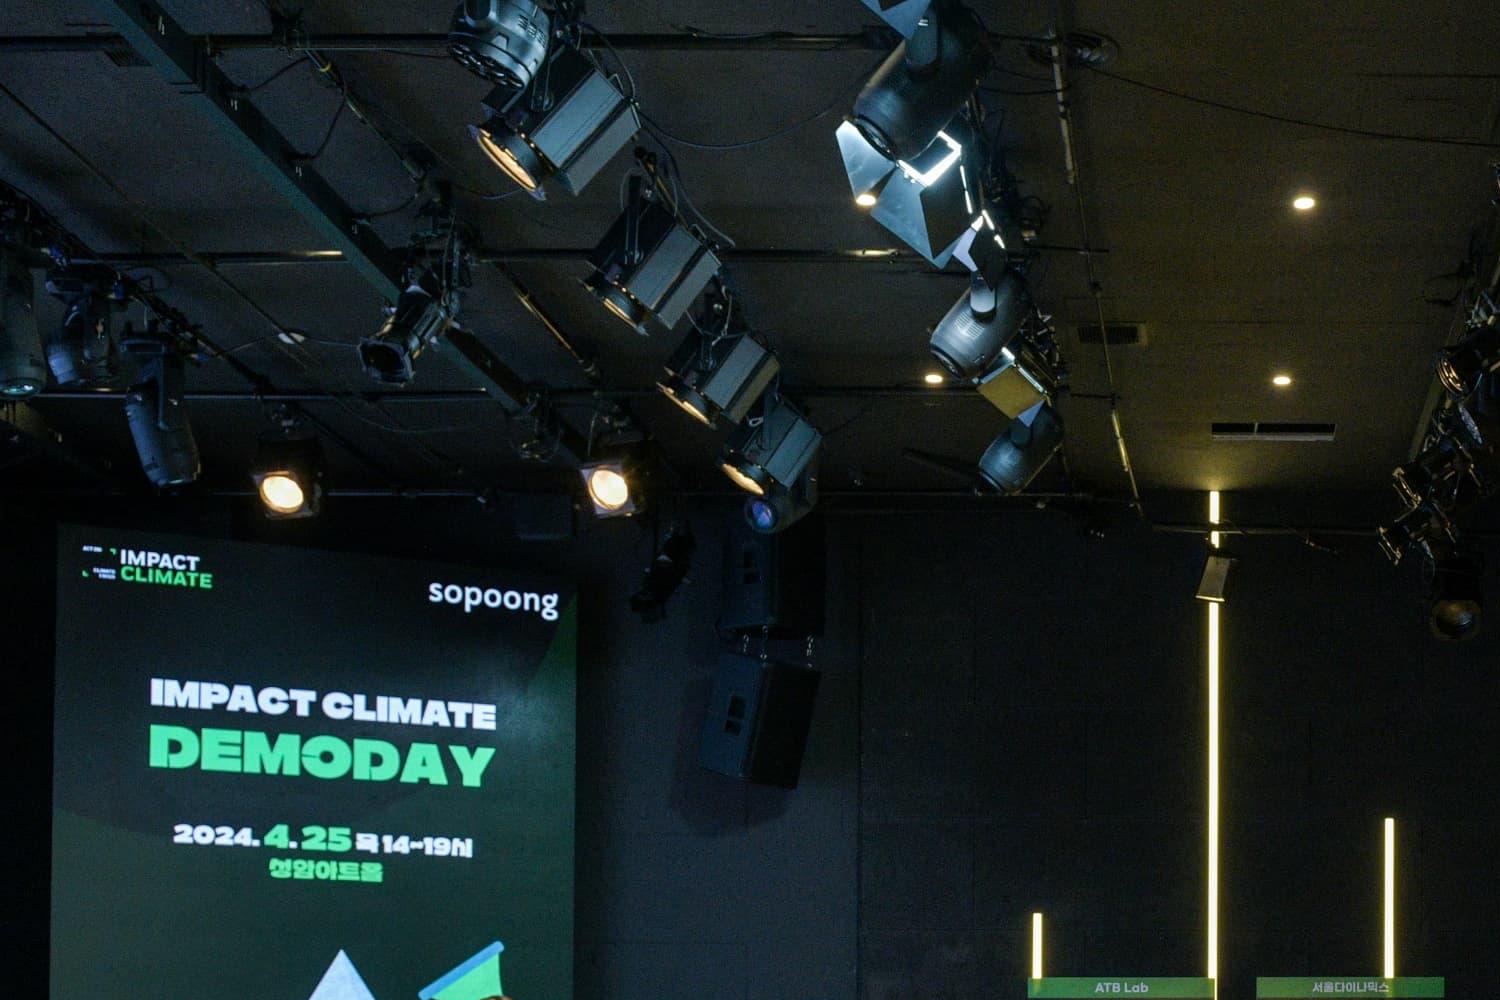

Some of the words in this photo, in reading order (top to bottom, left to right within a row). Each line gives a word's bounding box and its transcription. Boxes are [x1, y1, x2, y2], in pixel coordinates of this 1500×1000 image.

[120, 549, 201, 571] IMPACT
[120, 566, 213, 589] CLIMATE
[429, 582, 559, 620] sopoong
[150, 678, 317, 717] IMPACT
[321, 691, 497, 730] CLIMATE
[149, 724, 496, 788] DEMODAY
[1094, 982, 1121, 994] ATB
[1124, 982, 1149, 994] Lab
[1312, 981, 1390, 993] 서울다이나믹스
